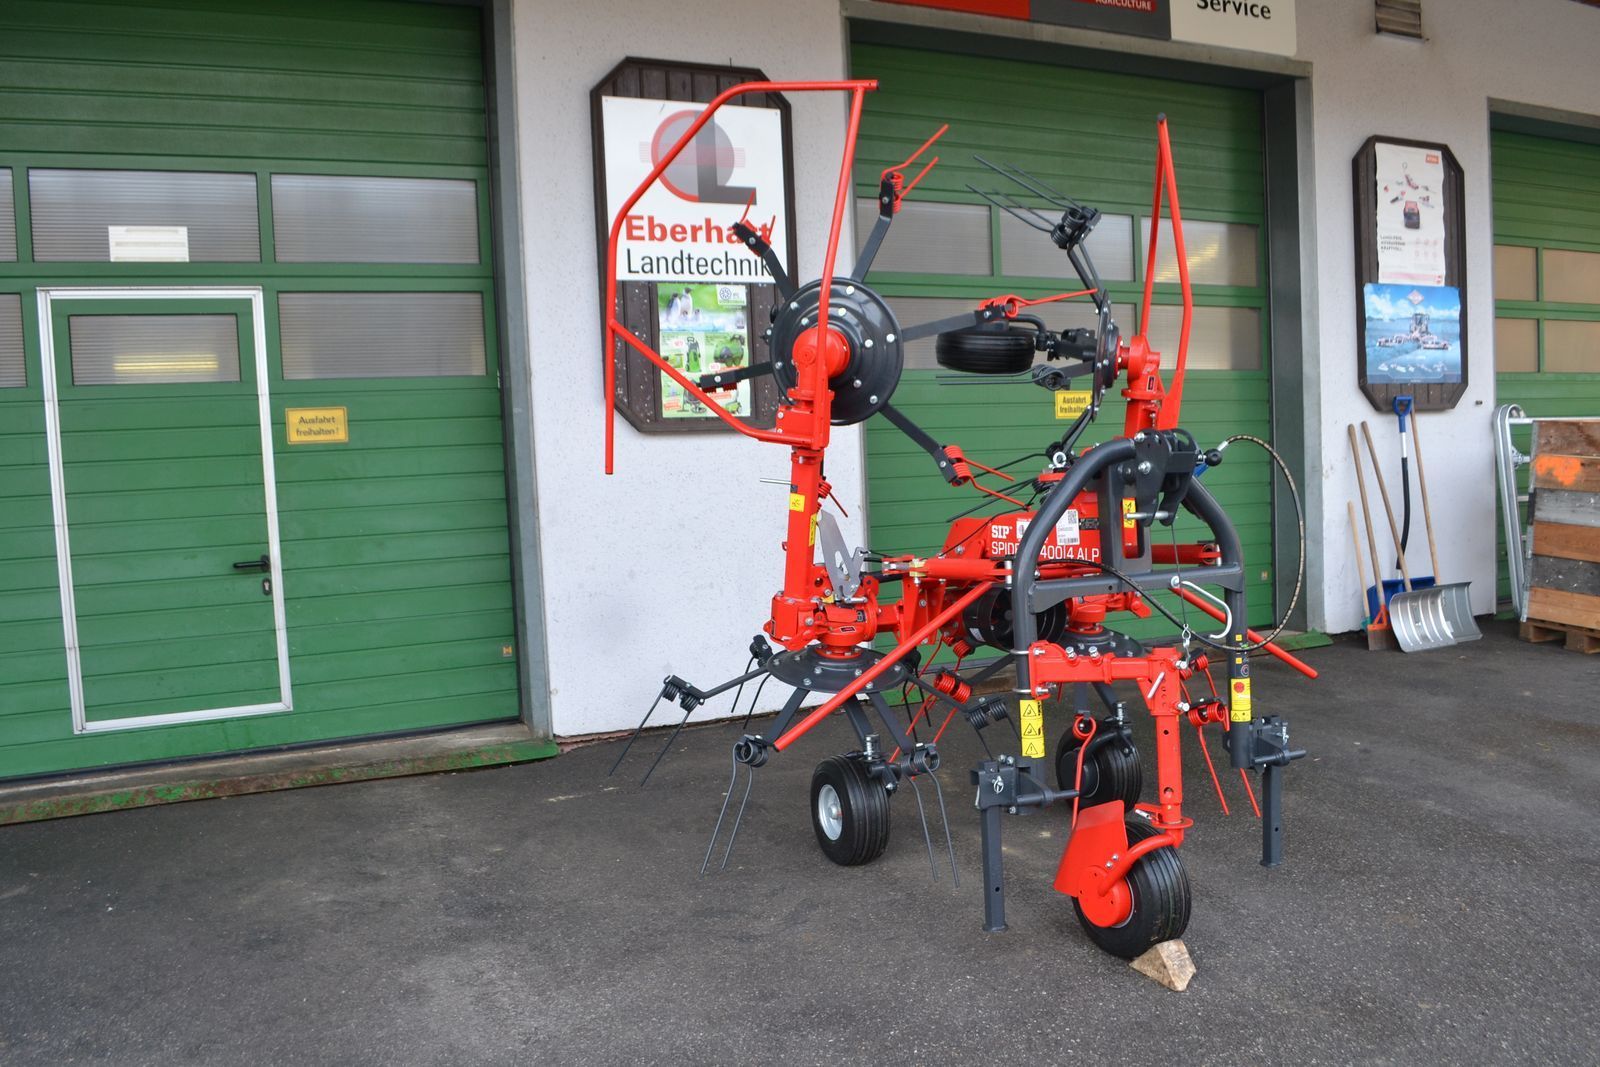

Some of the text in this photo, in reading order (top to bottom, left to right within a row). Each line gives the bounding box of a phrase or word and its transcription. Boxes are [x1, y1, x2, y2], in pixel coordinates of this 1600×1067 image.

[625, 214, 772, 246] Eberhat
[627, 248, 773, 277] Landtechnik
[299, 415, 336, 425] Ausfahrt
[1076, 547, 1100, 562] ALP
